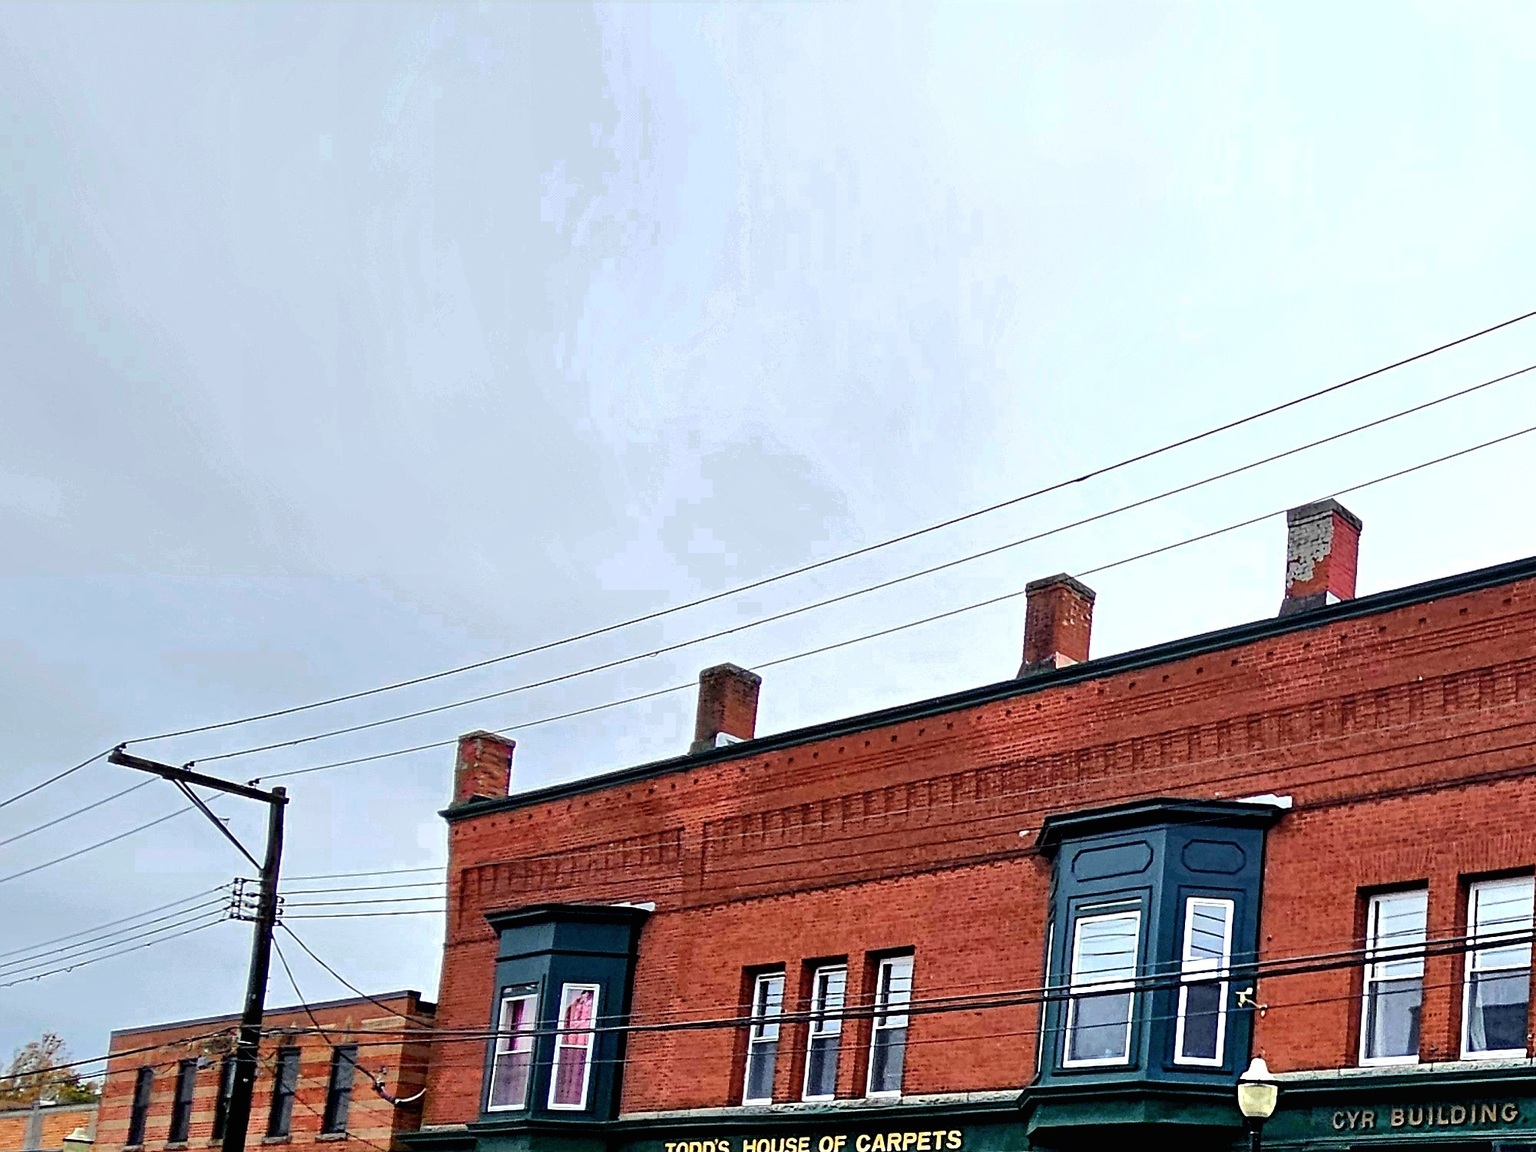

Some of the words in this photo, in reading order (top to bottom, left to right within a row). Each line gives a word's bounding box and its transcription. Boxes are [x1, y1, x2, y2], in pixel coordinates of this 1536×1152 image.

[1333, 1110, 1375, 1130] CYR
[1390, 1103, 1519, 1127] BUILDING
[855, 1130, 962, 1152] CARPETS
